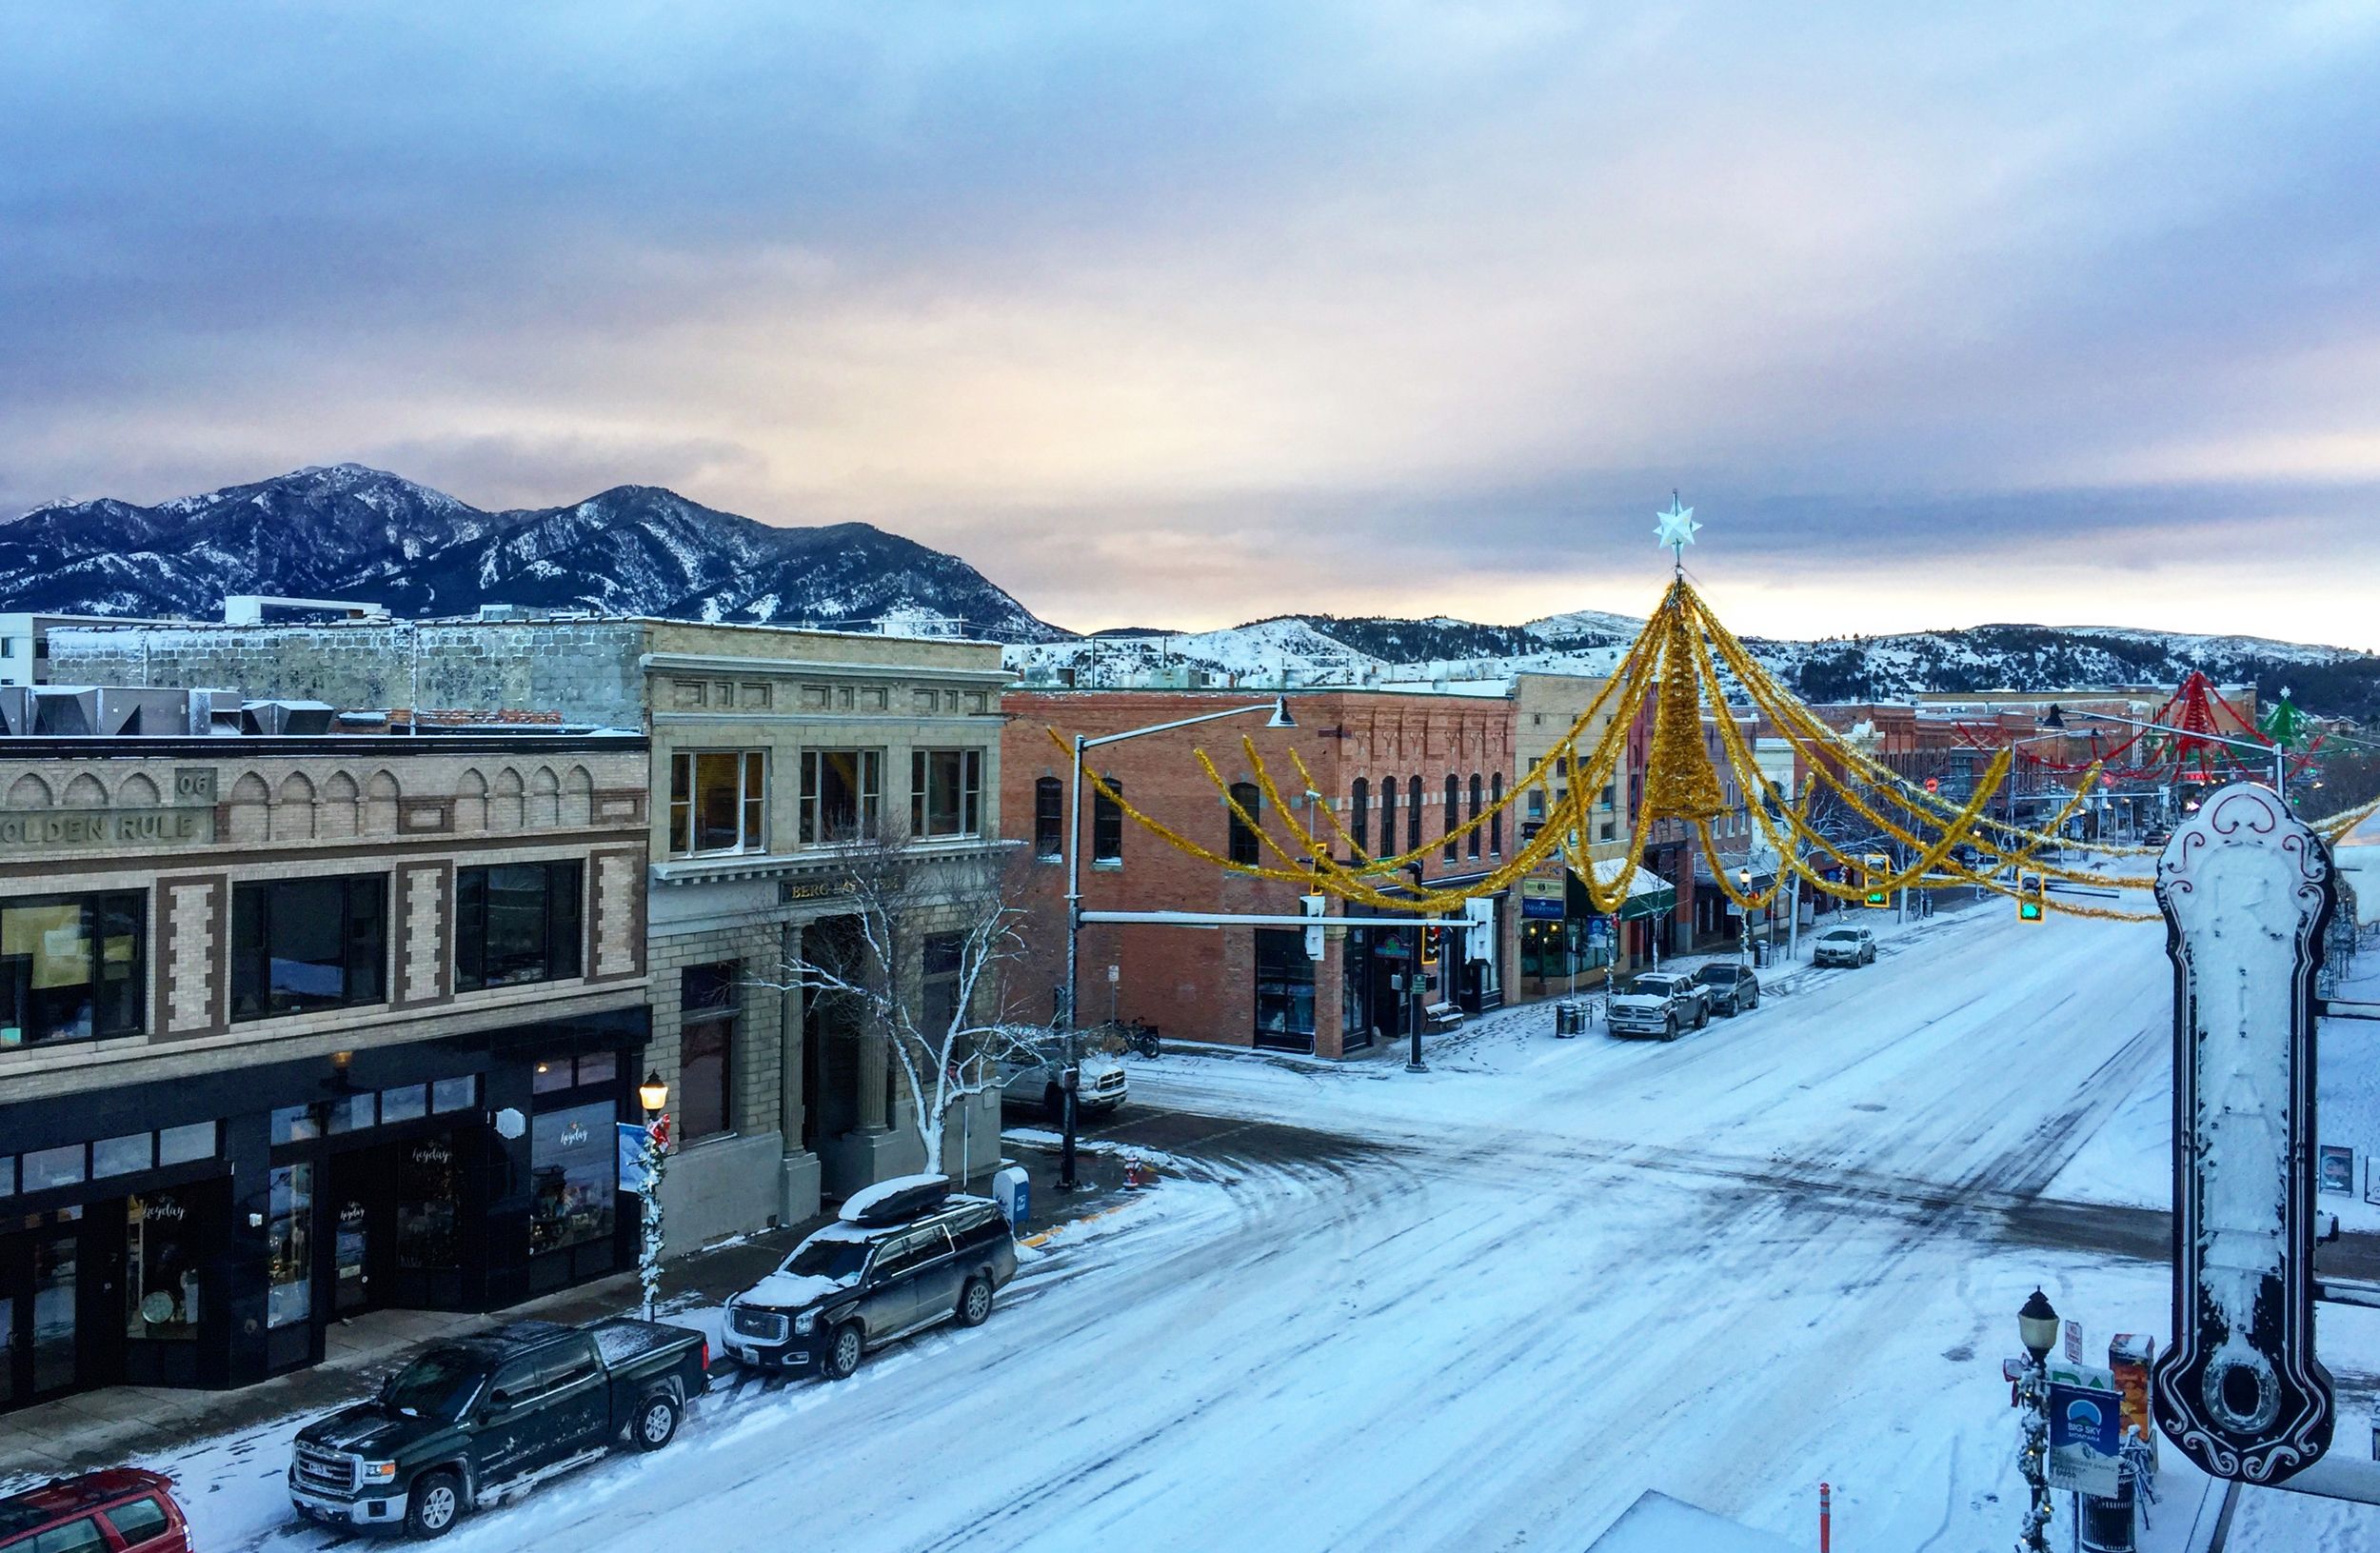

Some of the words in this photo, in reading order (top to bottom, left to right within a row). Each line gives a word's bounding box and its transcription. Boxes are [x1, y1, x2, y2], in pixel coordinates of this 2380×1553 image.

[178, 774, 208, 796] 06
[116, 814, 193, 840] RULE
[791, 884, 829, 899] BERG
[2068, 1423, 2084, 1433] BIG
[2085, 1424, 2102, 1436] SKY
